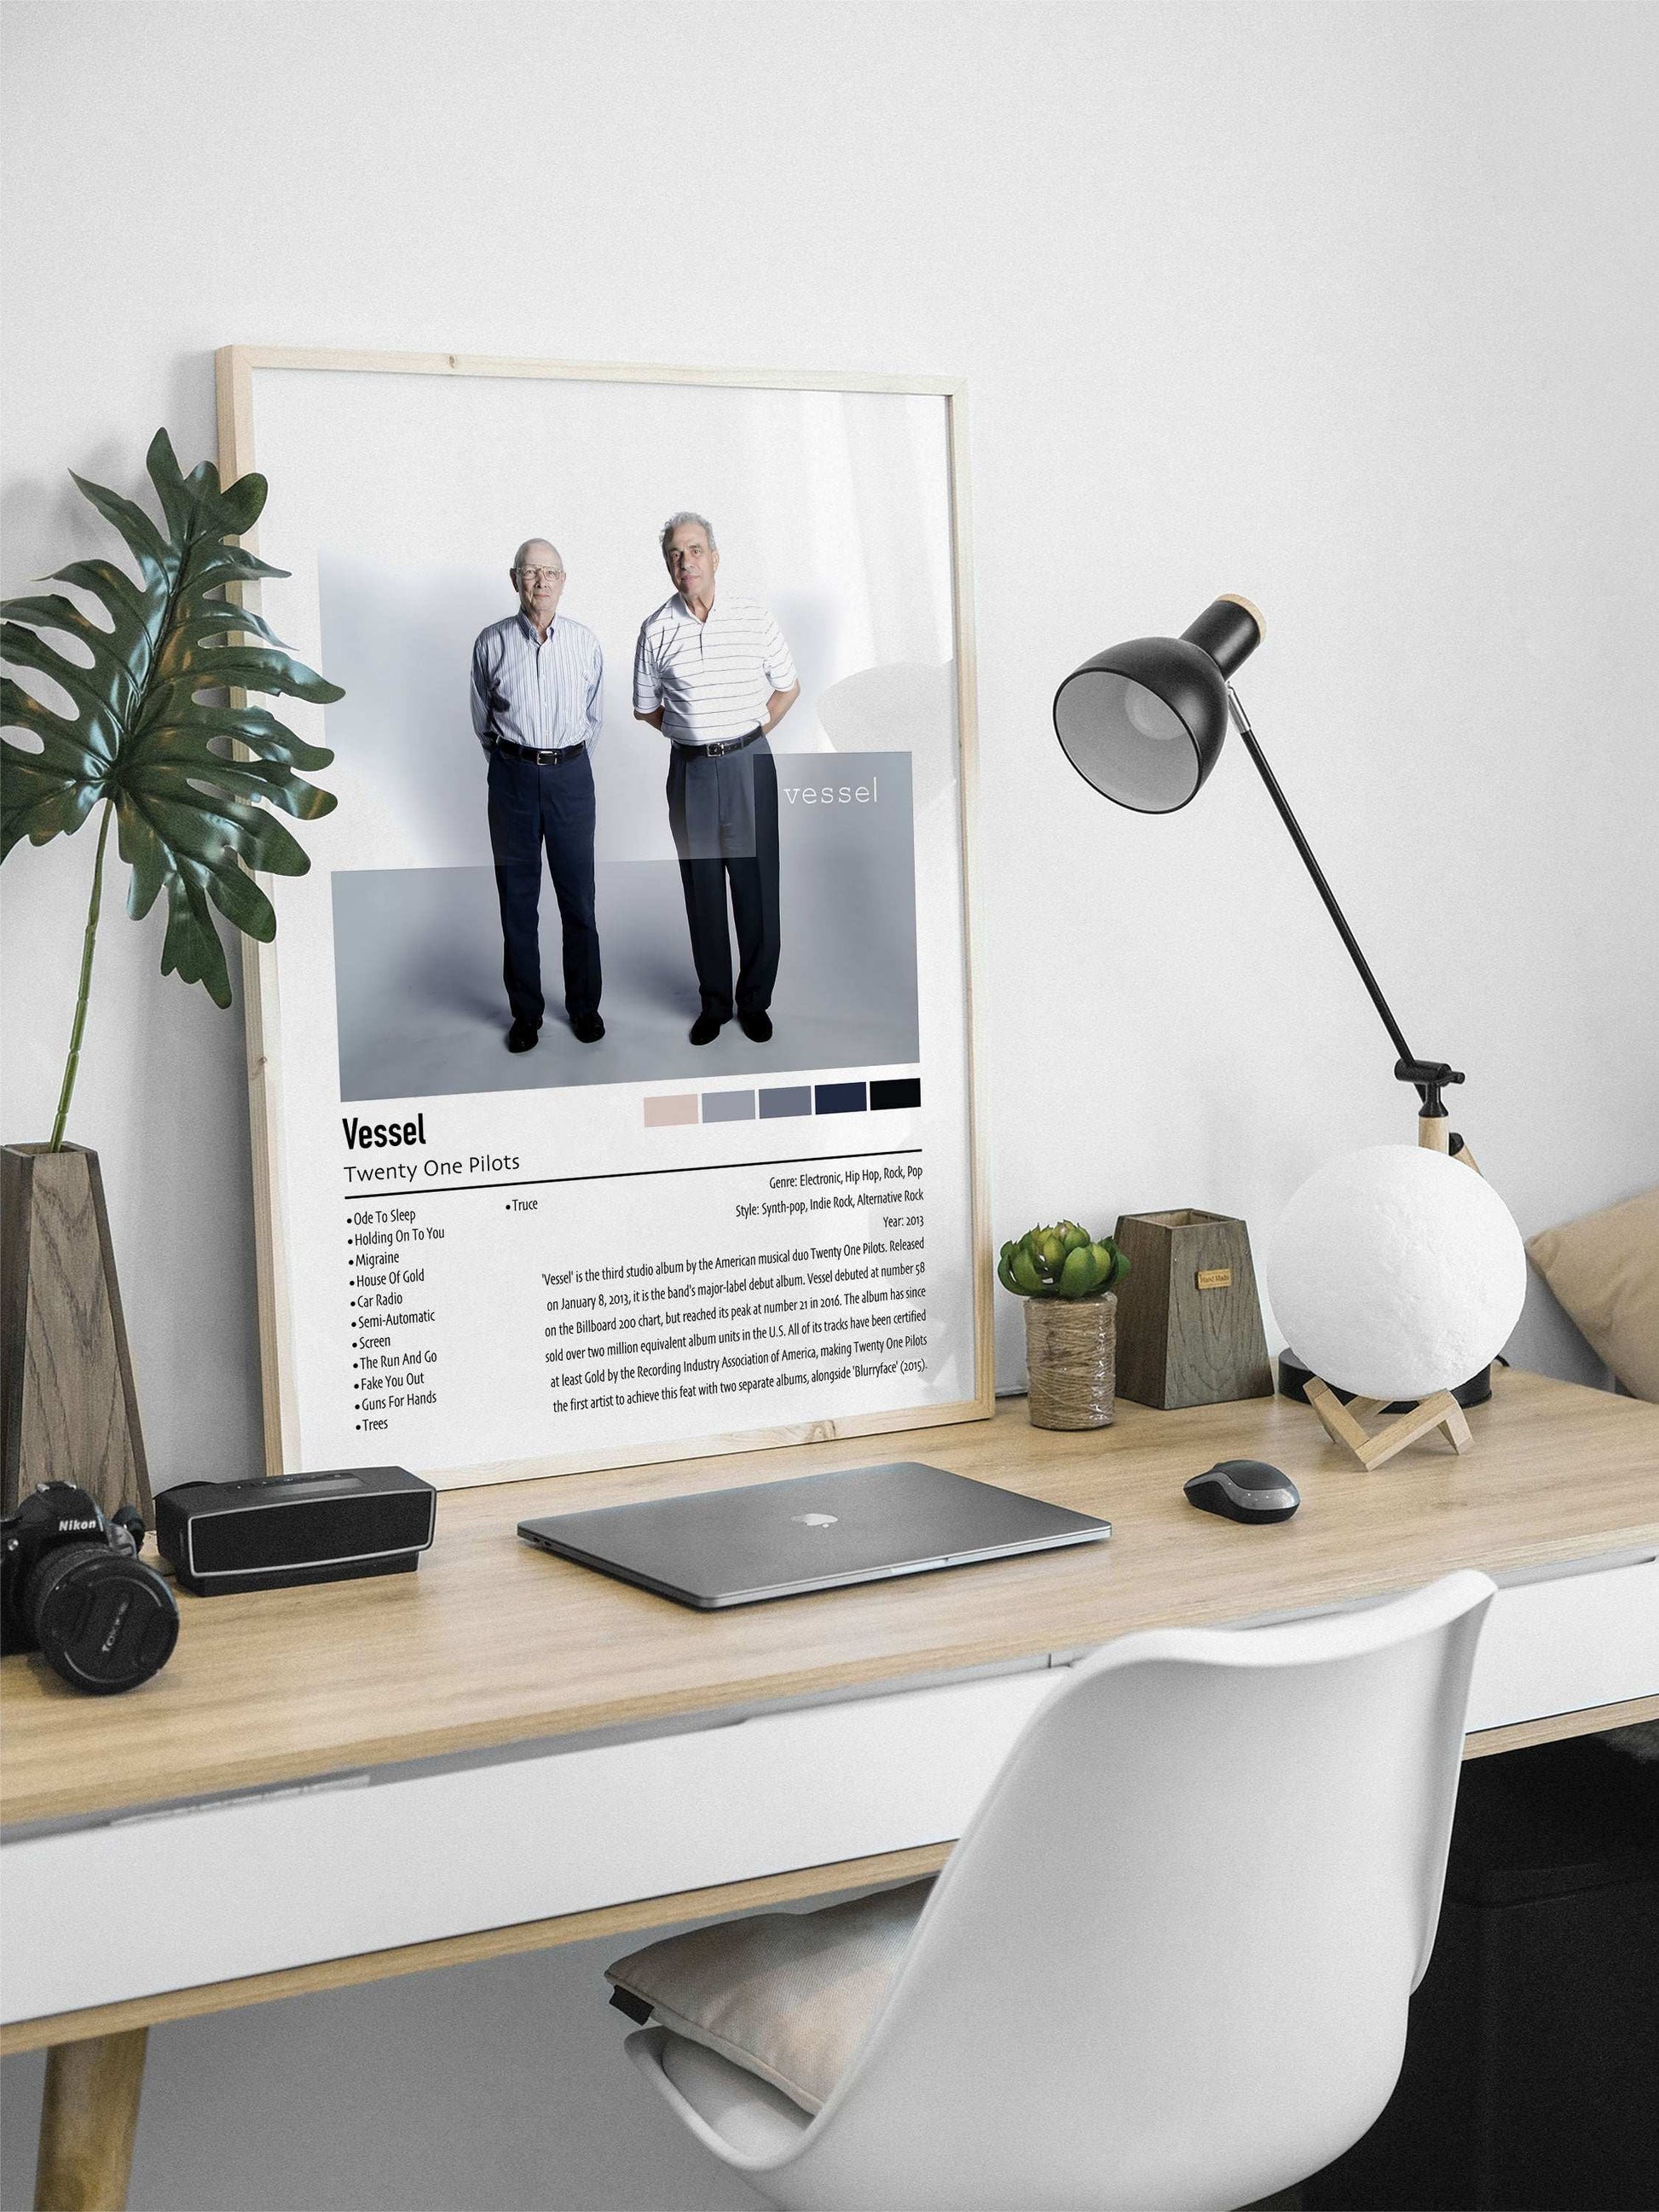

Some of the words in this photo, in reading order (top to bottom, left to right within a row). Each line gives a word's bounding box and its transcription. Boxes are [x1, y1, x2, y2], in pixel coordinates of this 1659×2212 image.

[783, 776, 877, 805] vessel
[342, 1113, 426, 1150] Vessel
[343, 1163, 418, 1183] Twenty
[424, 1159, 463, 1177] One
[469, 1154, 520, 1173] Pilots
[769, 1176, 798, 1190] Genre:
[800, 1171, 844, 1187] Electronic,
[845, 1169, 860, 1185] Hip
[862, 1168, 882, 1184] Hop,
[883, 1165, 905, 1180] Rock,
[907, 1165, 923, 1180] Pop
[512, 1198, 538, 1212] Truce
[735, 1202, 760, 1220] Style:
[761, 1200, 808, 1218] Synth-pop,
[810, 1196, 831, 1211] Indie
[833, 1194, 856, 1209] Rock,
[856, 1191, 903, 1207] Alternative
[904, 1188, 924, 1202] Rock
[353, 1210, 373, 1225] Ode
[374, 1210, 388, 1224] To
[390, 1207, 416, 1225] Sleep
[882, 1216, 905, 1228] Year:
[905, 1215, 924, 1227] 2013
[355, 1230, 393, 1248] Holding
[396, 1229, 410, 1243] On
[411, 1228, 425, 1241] To
[425, 1226, 445, 1240] You
[356, 1251, 400, 1270] Migraine
[541, 1270, 574, 1286] 'Vessel'
[575, 1270, 583, 1283] is
[584, 1268, 600, 1283] the
[601, 1265, 624, 1281] third
[626, 1263, 654, 1278] studio
[655, 1261, 684, 1276] album
[685, 1259, 697, 1276] by
[698, 1257, 714, 1271] the
[714, 1254, 756, 1270] American
[758, 1249, 790, 1265] musical
[792, 1248, 809, 1262] duo
[810, 1246, 842, 1260] Twenty
[843, 1244, 861, 1257] One
[863, 1241, 887, 1254] Pilots.
[889, 1236, 925, 1253] Released
[356, 1274, 387, 1288] House
[389, 1270, 401, 1285] Of
[402, 1267, 425, 1283] Gold
[546, 1300, 559, 1312] on
[561, 1297, 597, 1311] January
[598, 1294, 607, 1308] 8,
[609, 1294, 632, 1306] 2013,
[633, 1289, 640, 1303] it
[642, 1289, 650, 1302] is
[650, 1287, 666, 1301] the
[667, 1283, 697, 1300] band's
[697, 1277, 747, 1299] major-label
[749, 1277, 775, 1291] debut
[775, 1274, 806, 1288] album.
[806, 1269, 833, 1285] Vessel
[834, 1265, 869, 1283] debuted
[870, 1266, 880, 1278] at
[881, 1262, 915, 1277] number
[915, 1261, 926, 1277] 58
[357, 1294, 374, 1308] Car
[376, 1291, 403, 1306] Radio
[358, 1309, 436, 1329] Semi-Automatic
[545, 1326, 557, 1338] on
[558, 1322, 575, 1336] the
[576, 1317, 616, 1335] Billboard
[618, 1317, 637, 1329] 200
[638, 1313, 663, 1328] chart,
[665, 1311, 681, 1325] but
[682, 1306, 717, 1323] reached
[719, 1306, 730, 1319] its
[731, 1303, 752, 1321] peak
[753, 1303, 762, 1316] at
[763, 1299, 798, 1314] number
[799, 1300, 808, 1311] 21
[810, 1296, 818, 1309] in
[820, 1294, 842, 1308] 2016.
[843, 1292, 860, 1306] The
[861, 1289, 888, 1304] album
[890, 1288, 905, 1300] has
[905, 1286, 927, 1300] since
[359, 1336, 391, 1350] Screen
[545, 1347, 564, 1364] sold
[565, 1349, 587, 1361] over
[587, 1346, 605, 1358] two
[607, 1341, 639, 1356] million
[640, 1335, 687, 1355] equivalent
[688, 1333, 717, 1347] album
[718, 1329, 741, 1344] units
[742, 1329, 751, 1341] in
[752, 1326, 767, 1341] the
[769, 1324, 786, 1339] U.S.
[788, 1322, 800, 1336] All
[801, 1321, 811, 1335] of
[812, 1321, 823, 1334] its
[824, 1317, 848, 1332] tracks
[850, 1317, 870, 1329] have
[871, 1314, 892, 1327] been
[893, 1308, 927, 1324] certified
[359, 1356, 379, 1370] The
[380, 1355, 400, 1369] Run
[402, 1350, 422, 1366] And
[424, 1349, 437, 1364] Go
[550, 1375, 560, 1388] at
[562, 1373, 583, 1387] least
[584, 1369, 605, 1384] Gold
[607, 1368, 619, 1385] by
[620, 1366, 635, 1380] the
[637, 1362, 681, 1378] Recording
[683, 1358, 720, 1373] Industry
[721, 1352, 769, 1369] Association
[771, 1349, 780, 1363] of
[781, 1346, 818, 1362] America,
[820, 1342, 853, 1358] making
[853, 1340, 885, 1354] Twenty
[886, 1337, 904, 1350] One
[905, 1334, 928, 1347] Pilots
[361, 1375, 384, 1391] Fake
[384, 1375, 404, 1388] You
[406, 1372, 425, 1386] Out
[552, 1399, 569, 1413] the
[569, 1398, 589, 1411] first
[590, 1394, 614, 1409] artist
[615, 1394, 625, 1406] to
[627, 1390, 660, 1404] achieve
[661, 1387, 678, 1400] this
[679, 1385, 697, 1398] feat
[697, 1381, 718, 1396] with
[720, 1381, 737, 1393] two
[738, 1376, 774, 1394] separate
[776, 1373, 810, 1387] albums,
[811, 1366, 852, 1384] alongside
[852, 1360, 899, 1378] 'Blurryface'
[899, 1358, 928, 1375] (2015).
[361, 1398, 387, 1411] Guns
[388, 1395, 405, 1409] For
[407, 1390, 437, 1406] Hands
[361, 1418, 389, 1432] Trees
[59, 1520, 96, 1532] Nikon
